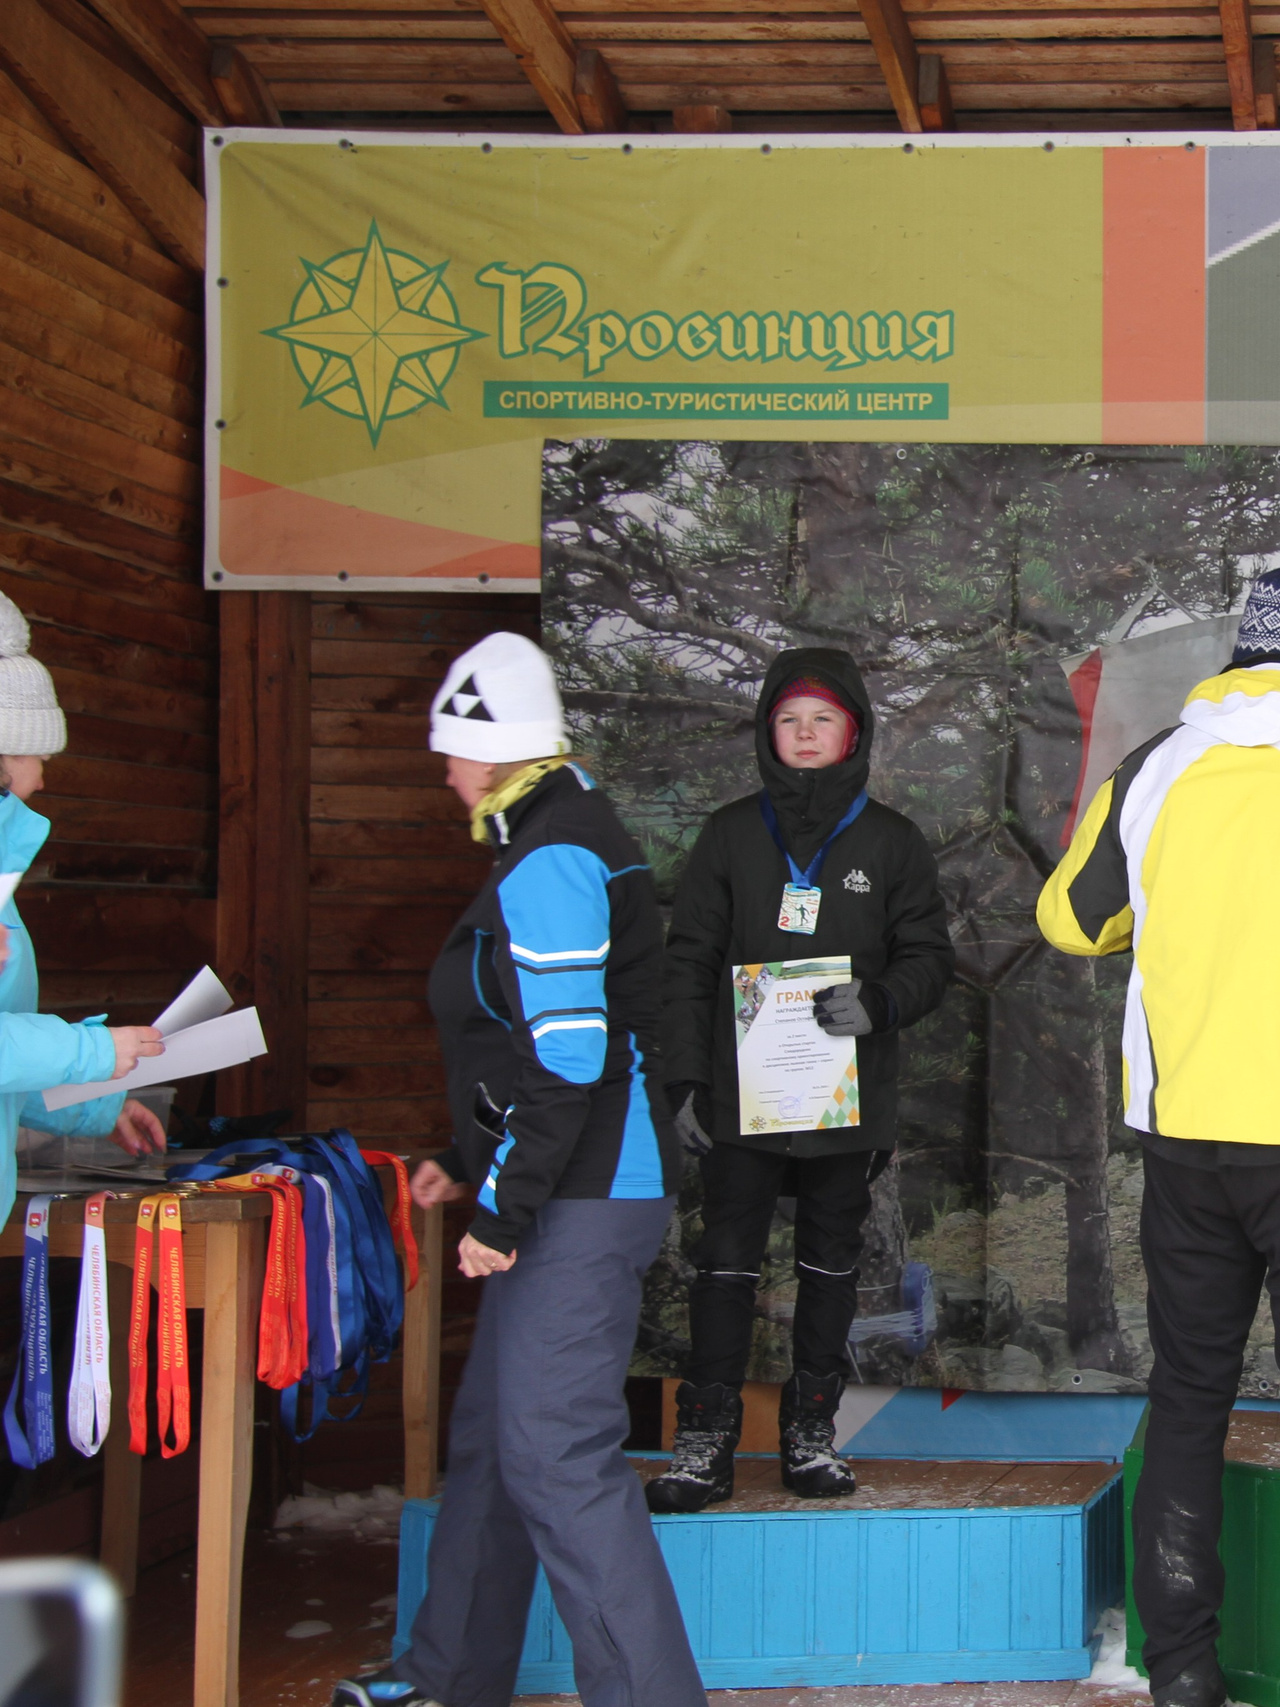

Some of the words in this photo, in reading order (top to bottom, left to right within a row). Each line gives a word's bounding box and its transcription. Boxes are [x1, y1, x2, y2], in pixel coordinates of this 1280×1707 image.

[475, 260, 955, 378] Провинция
[499, 389, 850, 412] СПОРТИВНО-ТУРИСТИЧЕСКИЙ
[857, 392, 933, 414] ЦЕНТР
[844, 880, 871, 893] Kappa
[779, 915, 790, 927] 2
[776, 988, 826, 1004] ГРАМ
[91, 1244, 102, 1316] ЧЕЛЯБИНСКАЯ
[135, 1246, 147, 1321] ЧЕЛЯБИНСКАЯ
[170, 1246, 182, 1320] ЧЕЛЯБИНСКАЯ
[38, 1327, 48, 1375] ОБЛАСТЬ
[94, 1318, 104, 1364] ОБЛАСТЬ
[173, 1322, 184, 1369] ОБЛАСТЬ
